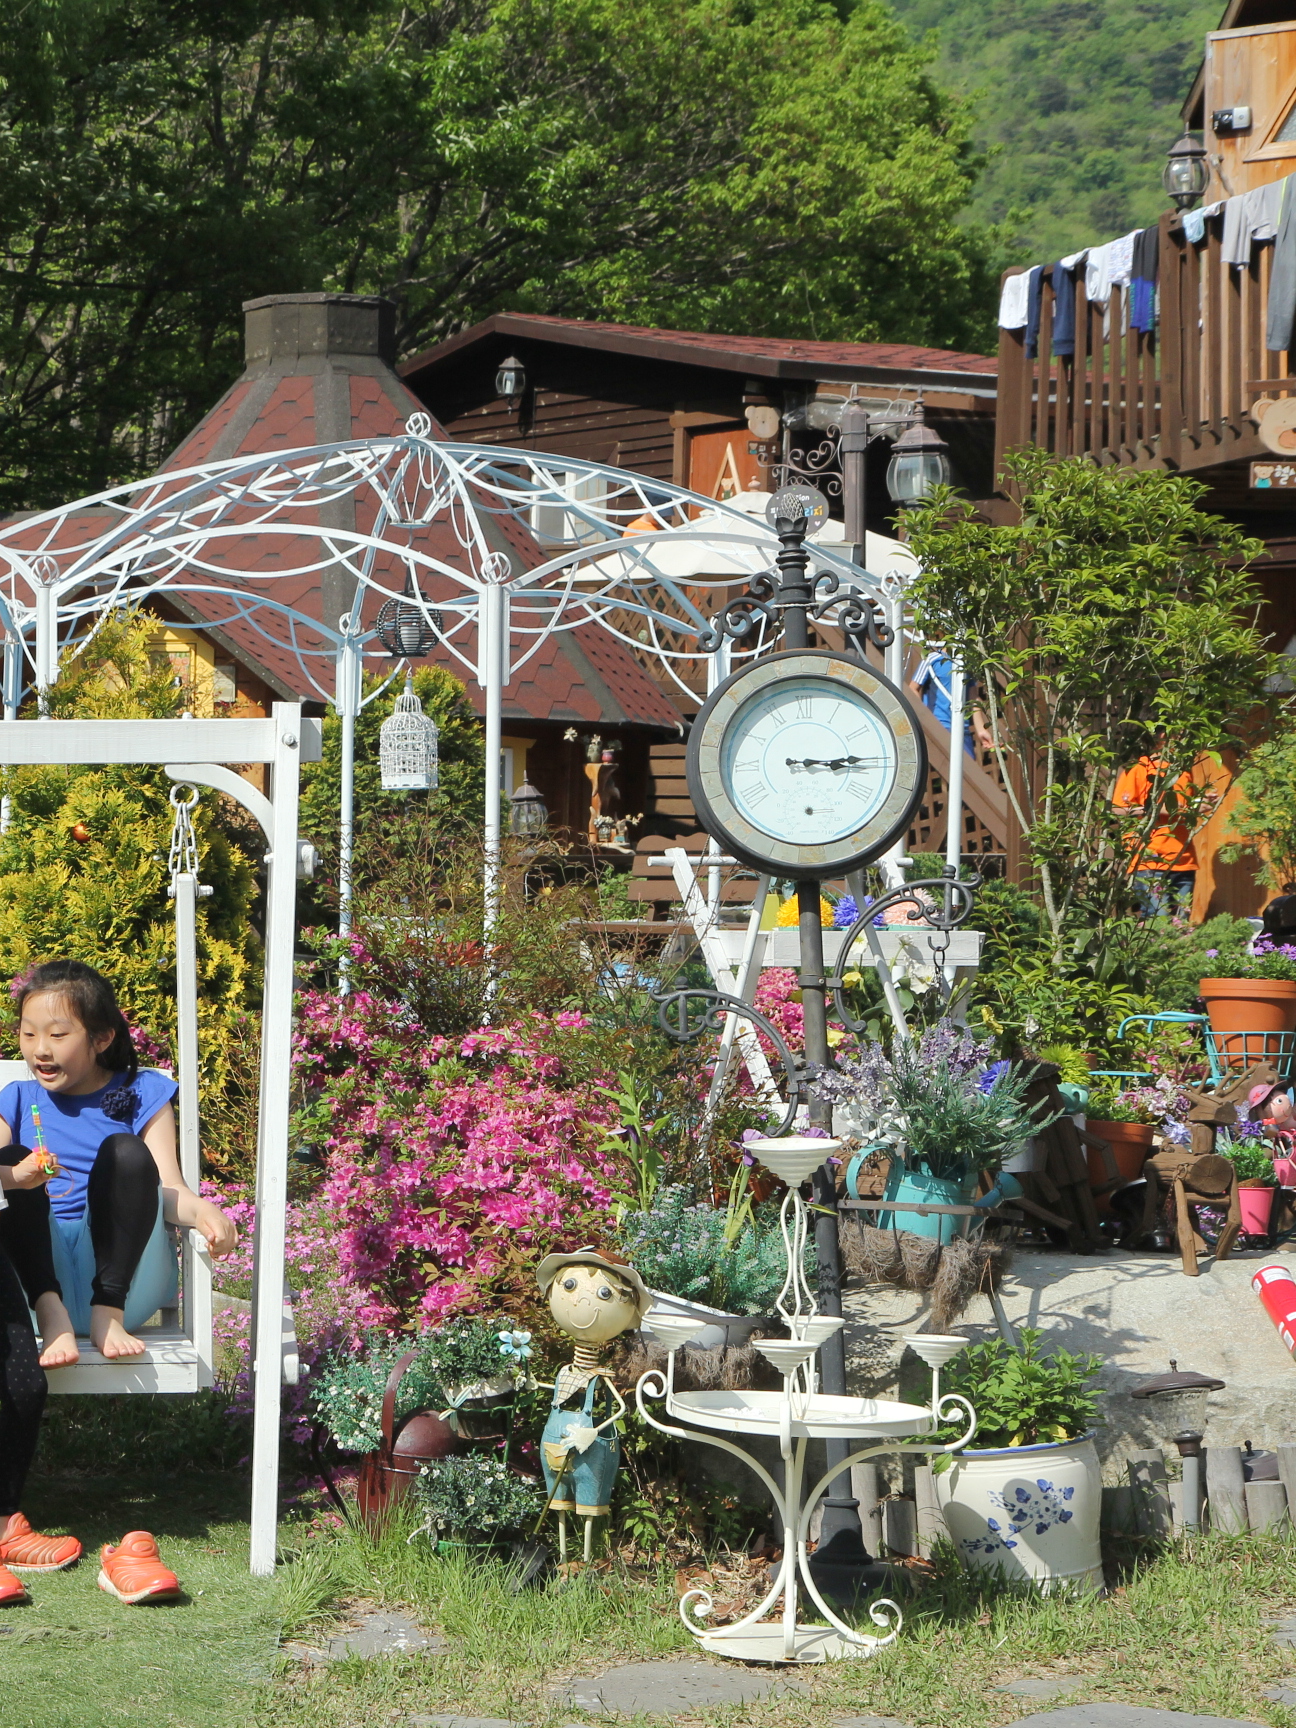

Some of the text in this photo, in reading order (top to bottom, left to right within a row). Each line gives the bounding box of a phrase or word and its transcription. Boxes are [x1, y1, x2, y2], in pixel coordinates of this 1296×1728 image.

[763, 702, 787, 728] XI
[795, 695, 813, 719] XII
[742, 728, 766, 746] X
